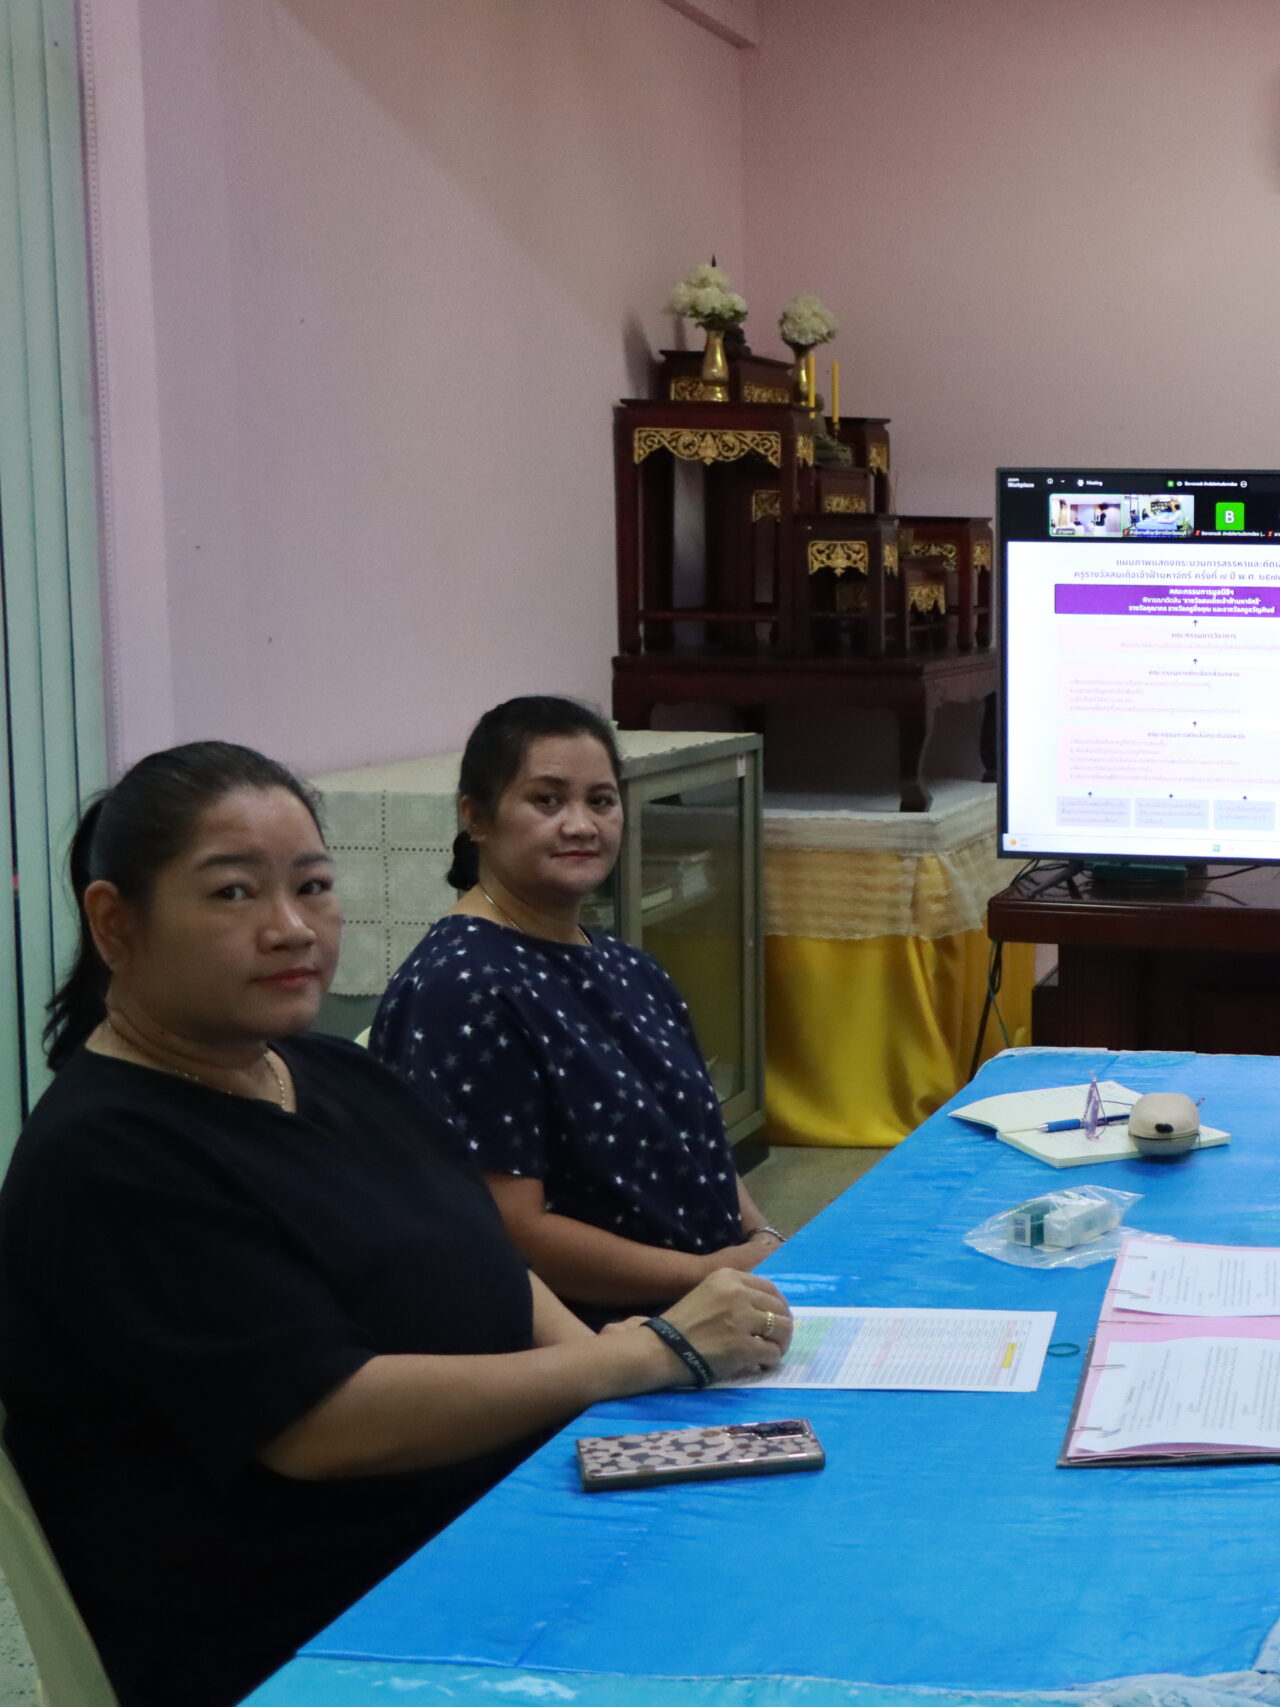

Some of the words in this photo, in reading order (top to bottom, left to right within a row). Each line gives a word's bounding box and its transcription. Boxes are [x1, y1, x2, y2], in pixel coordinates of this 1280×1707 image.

[1224, 510, 1235, 523] B
[1073, 569, 1192, 581] ครูรางวัลสมเด็จเจ้าฟ้ามหาจักรี
[1194, 568, 1218, 581] ครั้งที่
